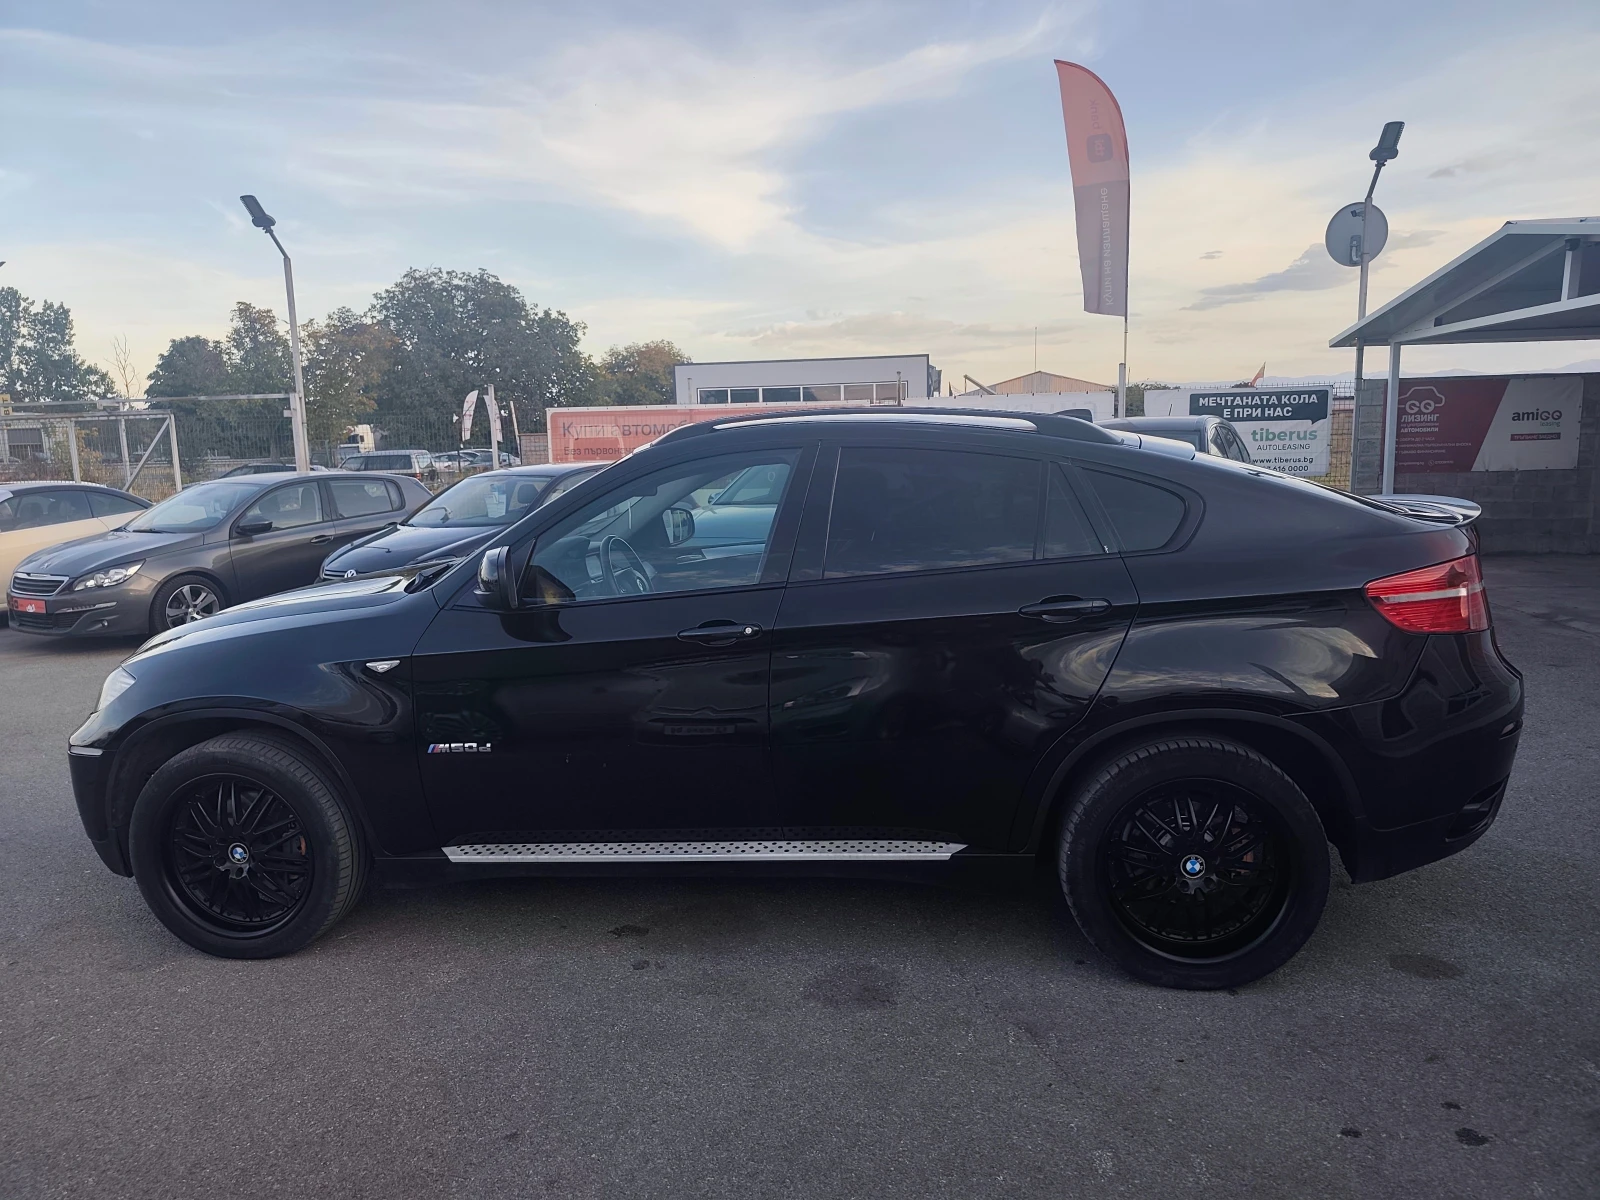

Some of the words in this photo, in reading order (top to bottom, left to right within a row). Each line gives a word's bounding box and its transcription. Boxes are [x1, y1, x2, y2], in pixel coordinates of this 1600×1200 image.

[1199, 395, 1278, 407] МЕЧТАНАТА
[1281, 394, 1318, 404] КОЛА
[1223, 409, 1230, 418] Е
[1234, 408, 1262, 418] ПРИ
[1264, 407, 1293, 417] НАС
[1401, 414, 1440, 423] ЛИЗИНГ
[562, 422, 605, 440] Купи
[1251, 428, 1318, 442] tiberus
[564, 446, 581, 456] Без
[1256, 443, 1311, 451] AUTOLEASING
[1252, 456, 1314, 465] www.tiberus.bg
